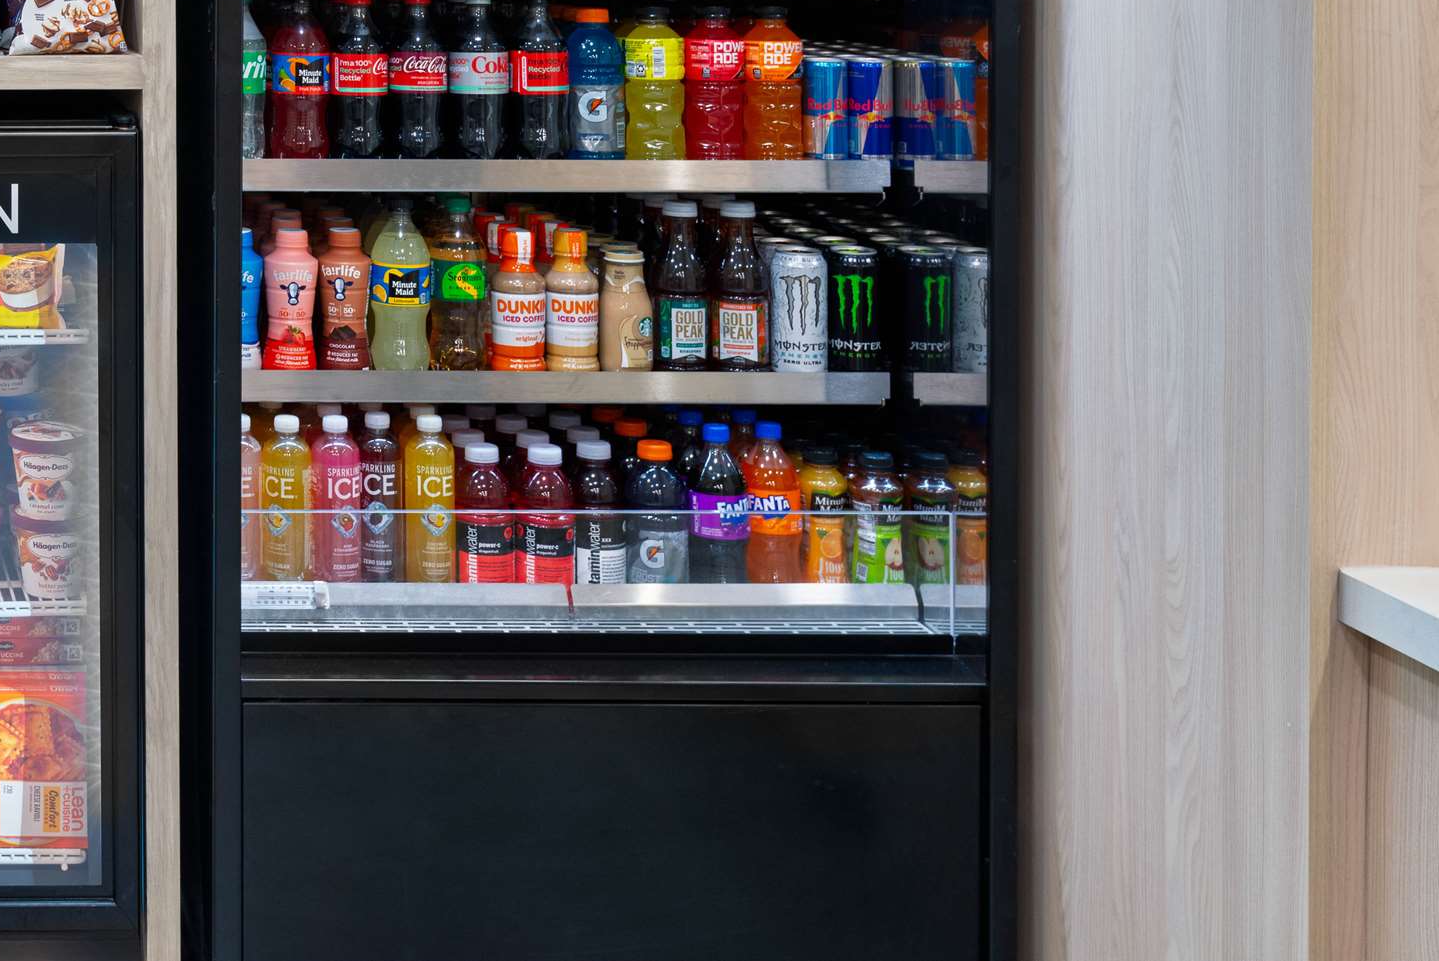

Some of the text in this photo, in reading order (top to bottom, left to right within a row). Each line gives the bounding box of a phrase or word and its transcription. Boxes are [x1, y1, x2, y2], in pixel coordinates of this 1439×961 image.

[713, 53, 739, 64] ADE
[763, 53, 792, 64] ADE
[298, 69, 322, 77] Minute
[340, 67, 372, 75] Recycled
[301, 76, 319, 84] Maid
[807, 97, 832, 111] Red
[273, 269, 313, 282] fairlife
[321, 264, 361, 279] fairlife
[391, 280, 417, 289] Minute
[395, 288, 414, 296] Maid
[502, 315, 521, 323] ICED
[557, 315, 576, 323] ICED
[675, 310, 704, 324] GOLD
[722, 311, 753, 326] GOLD
[675, 324, 704, 338] PEAK
[722, 326, 753, 340] PEAK
[416, 465, 453, 475] SPARKLING
[327, 477, 360, 500] ICE
[417, 475, 454, 498] ICE
[363, 558, 376, 566] ZERO
[71, 786, 84, 831] Lean
